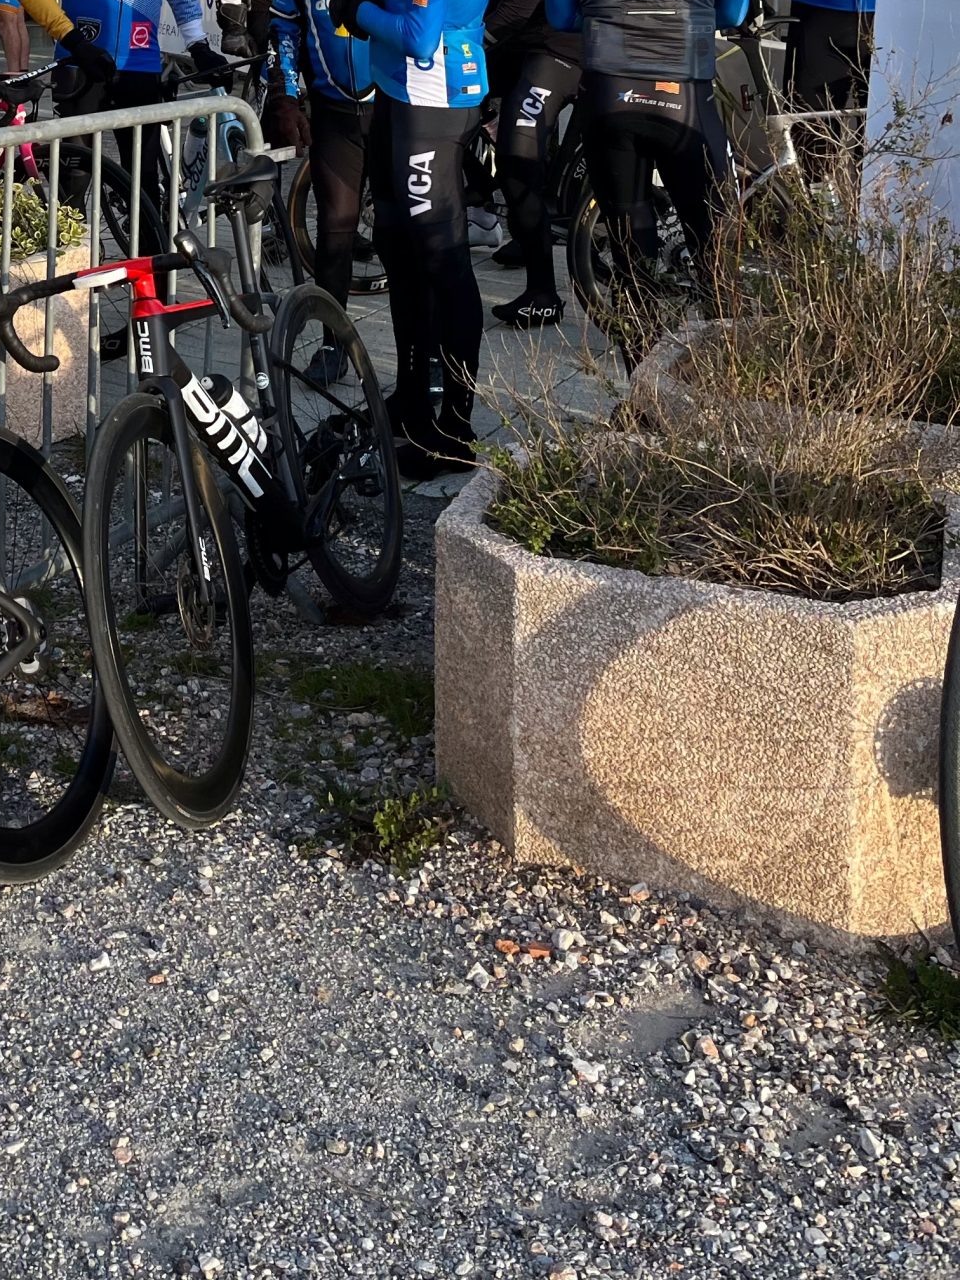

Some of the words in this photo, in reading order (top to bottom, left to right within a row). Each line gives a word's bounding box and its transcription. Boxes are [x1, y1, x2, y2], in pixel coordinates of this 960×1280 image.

[516, 86, 551, 127] VCA
[407, 150, 436, 217] VCA
[136, 321, 153, 373] BMC
